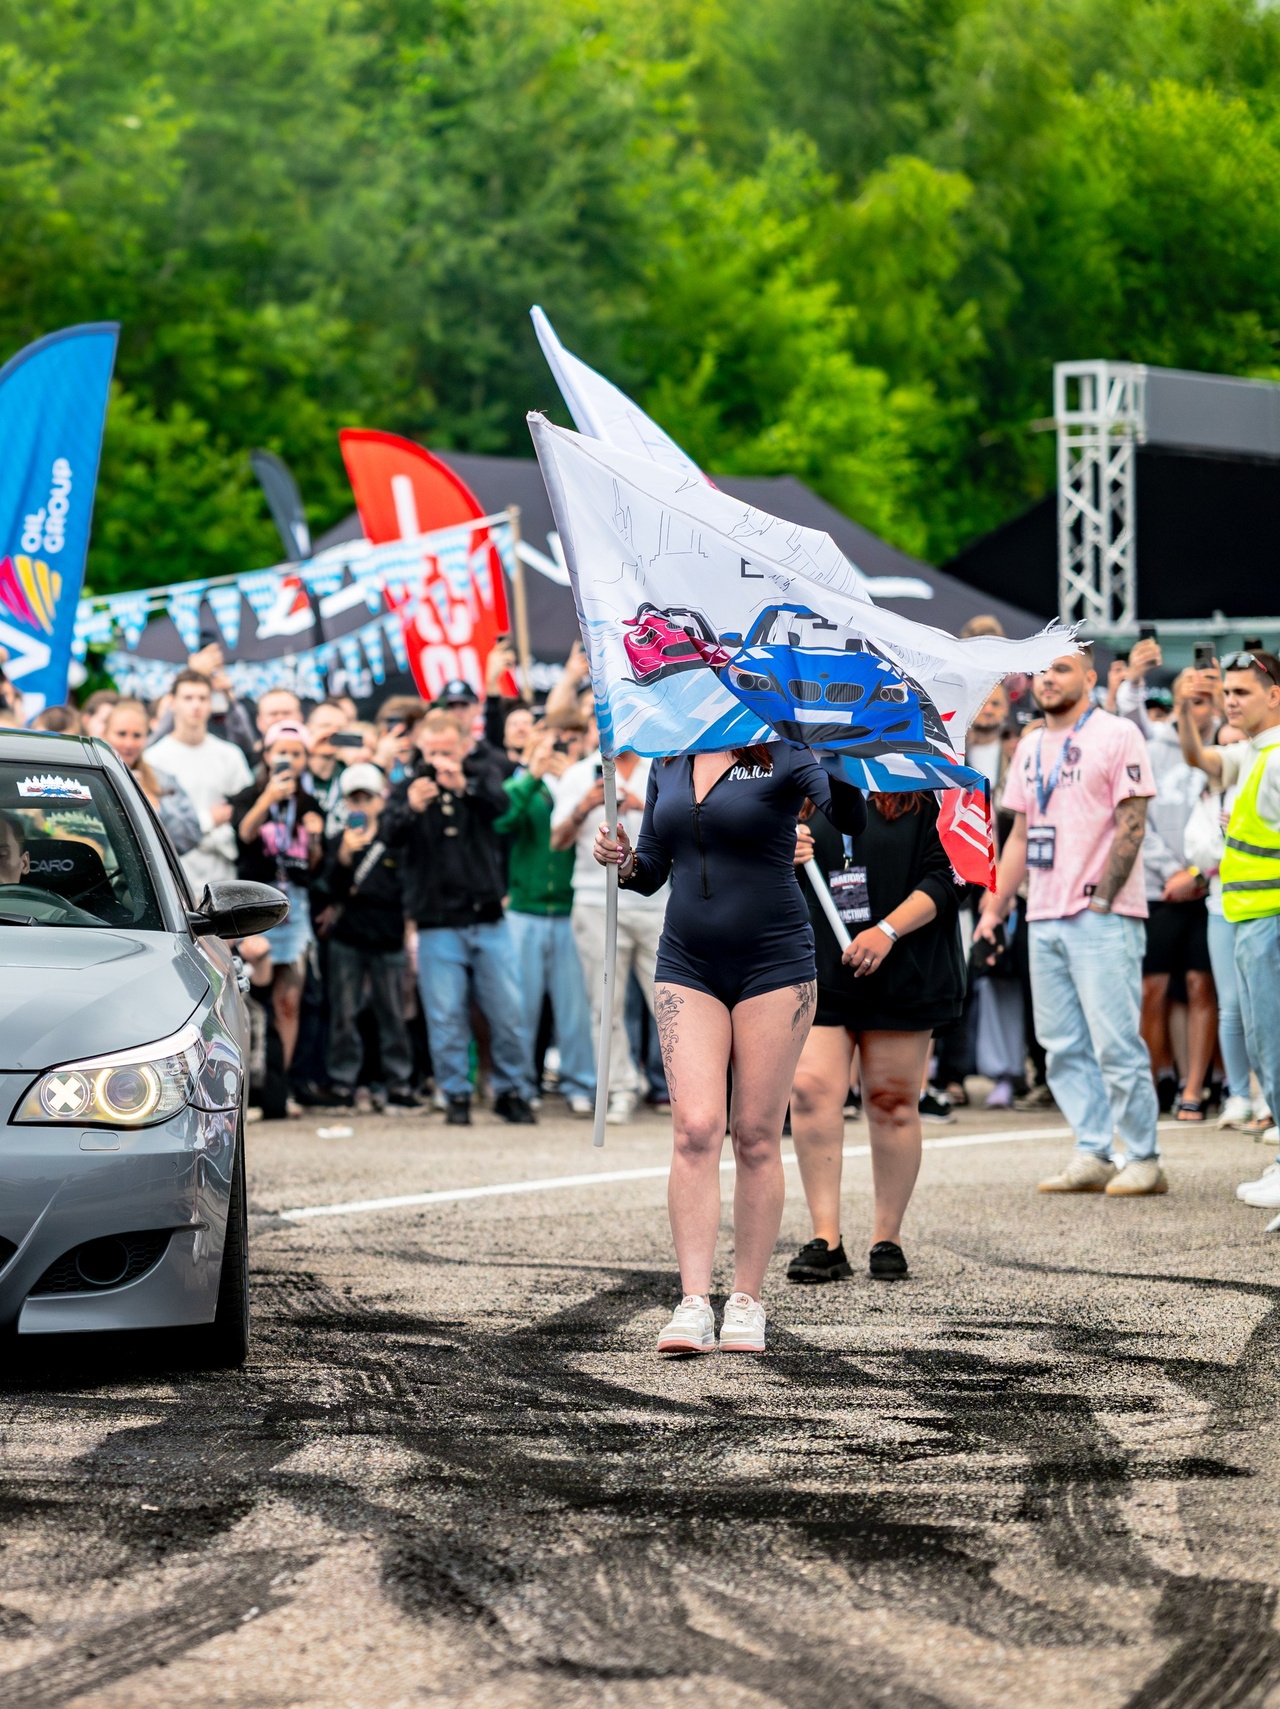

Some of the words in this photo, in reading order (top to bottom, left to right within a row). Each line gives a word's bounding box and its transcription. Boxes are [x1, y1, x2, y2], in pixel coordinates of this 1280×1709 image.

[43, 457, 73, 554] GROUP
[21, 507, 47, 554] OIL
[1026, 768, 1081, 788] MMI
[30, 859, 75, 873] CARO
